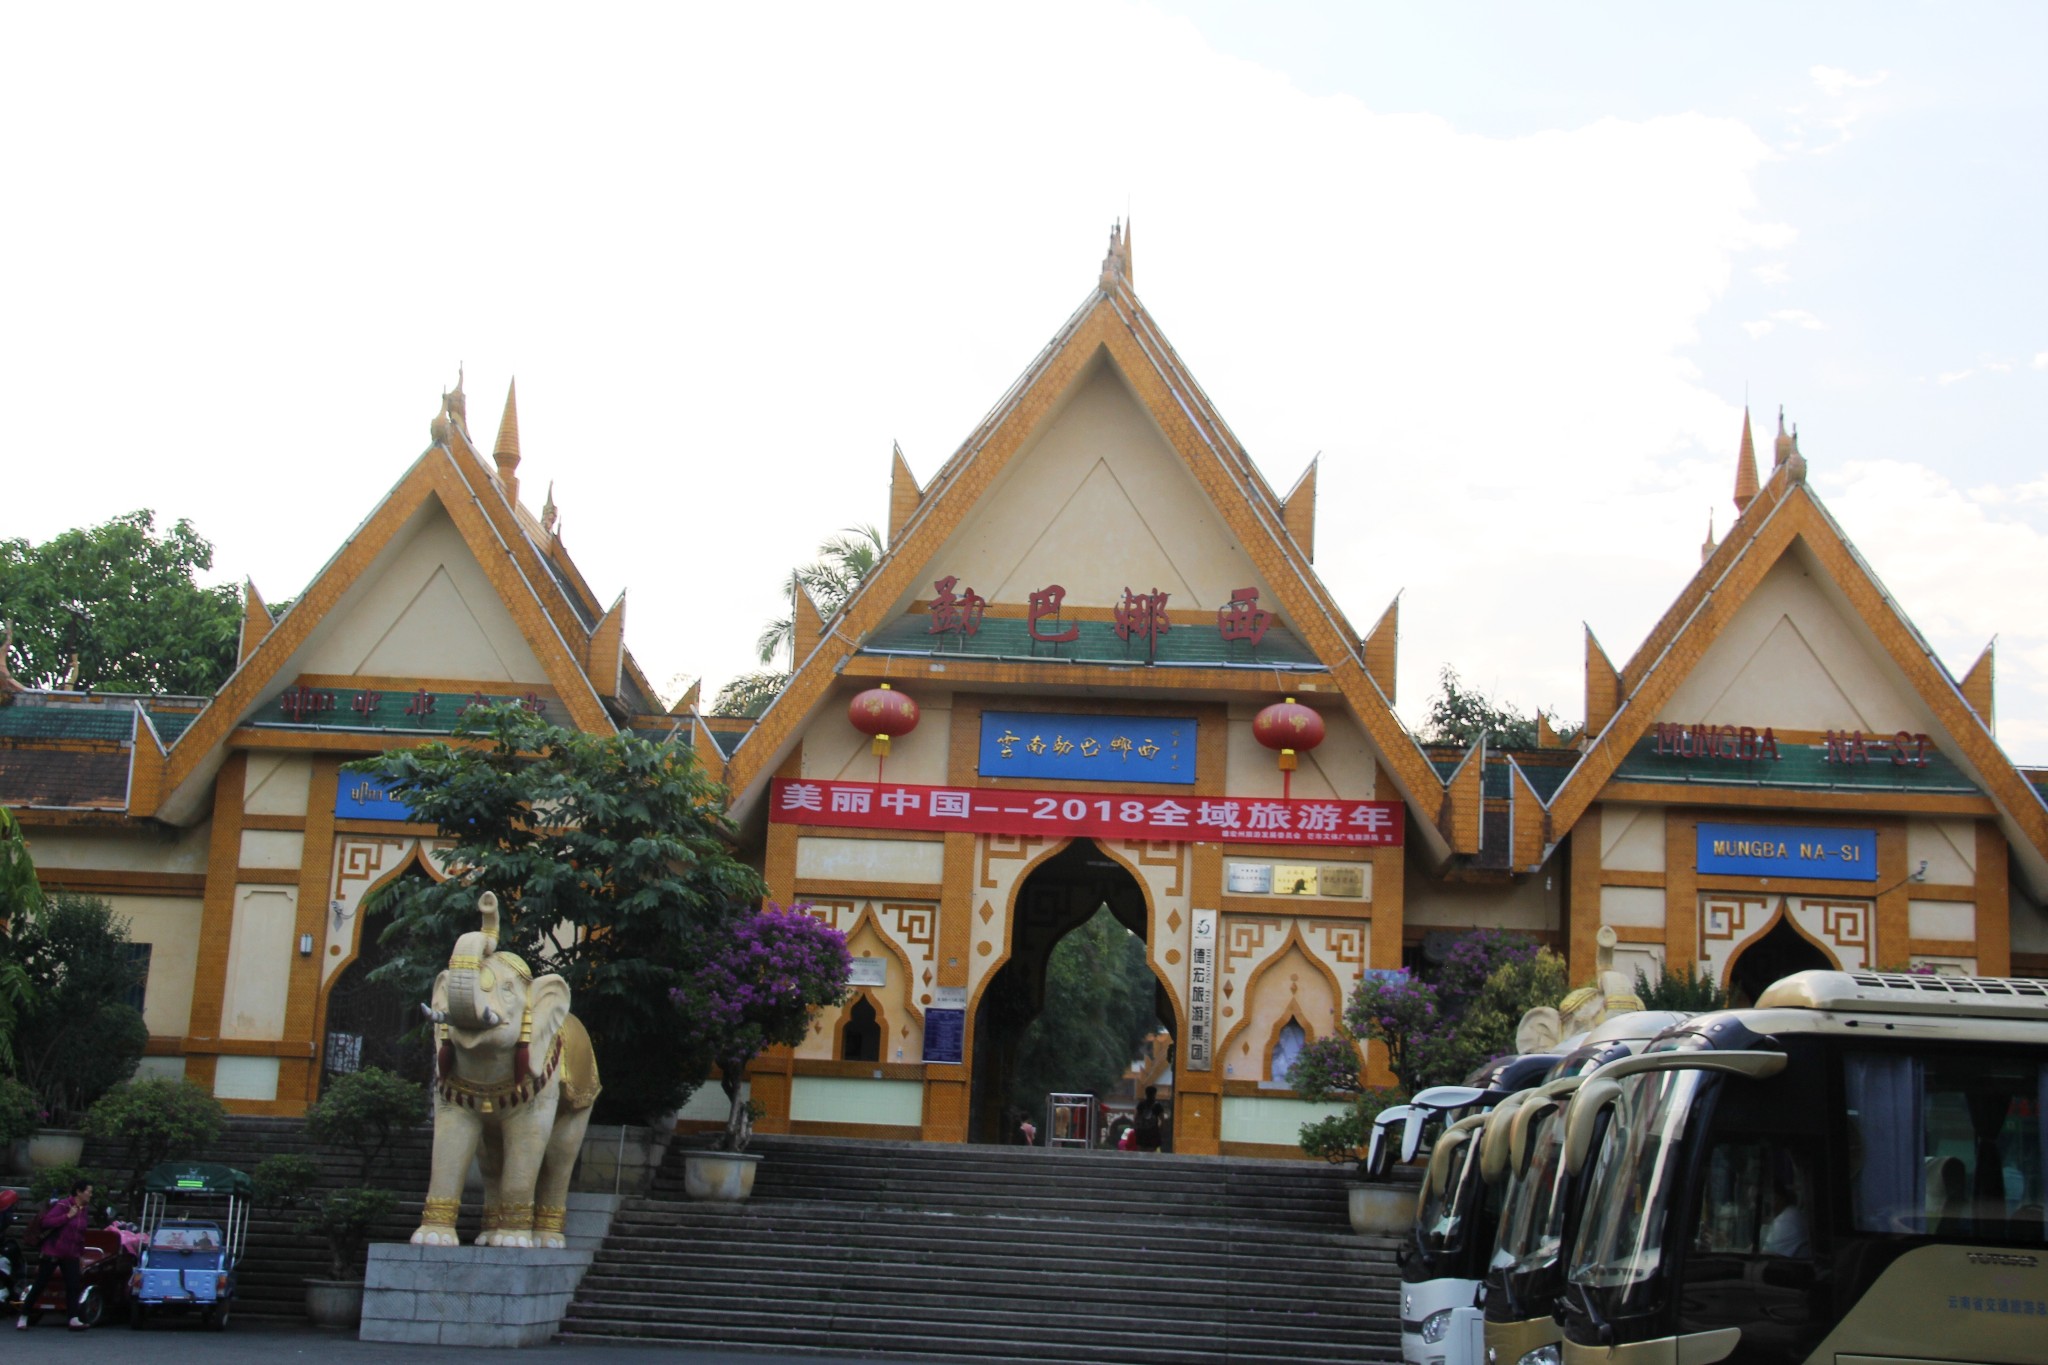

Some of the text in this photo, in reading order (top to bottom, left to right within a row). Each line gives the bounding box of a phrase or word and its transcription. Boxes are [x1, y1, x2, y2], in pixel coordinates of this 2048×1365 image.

[928, 575, 1274, 656] 勐巴娜西
[1657, 722, 1930, 768] MUNGBA NA-SI
[1713, 839, 1861, 862] MUNGBA NA-SI
[1191, 947, 1205, 1060] 德宏旅游集团
